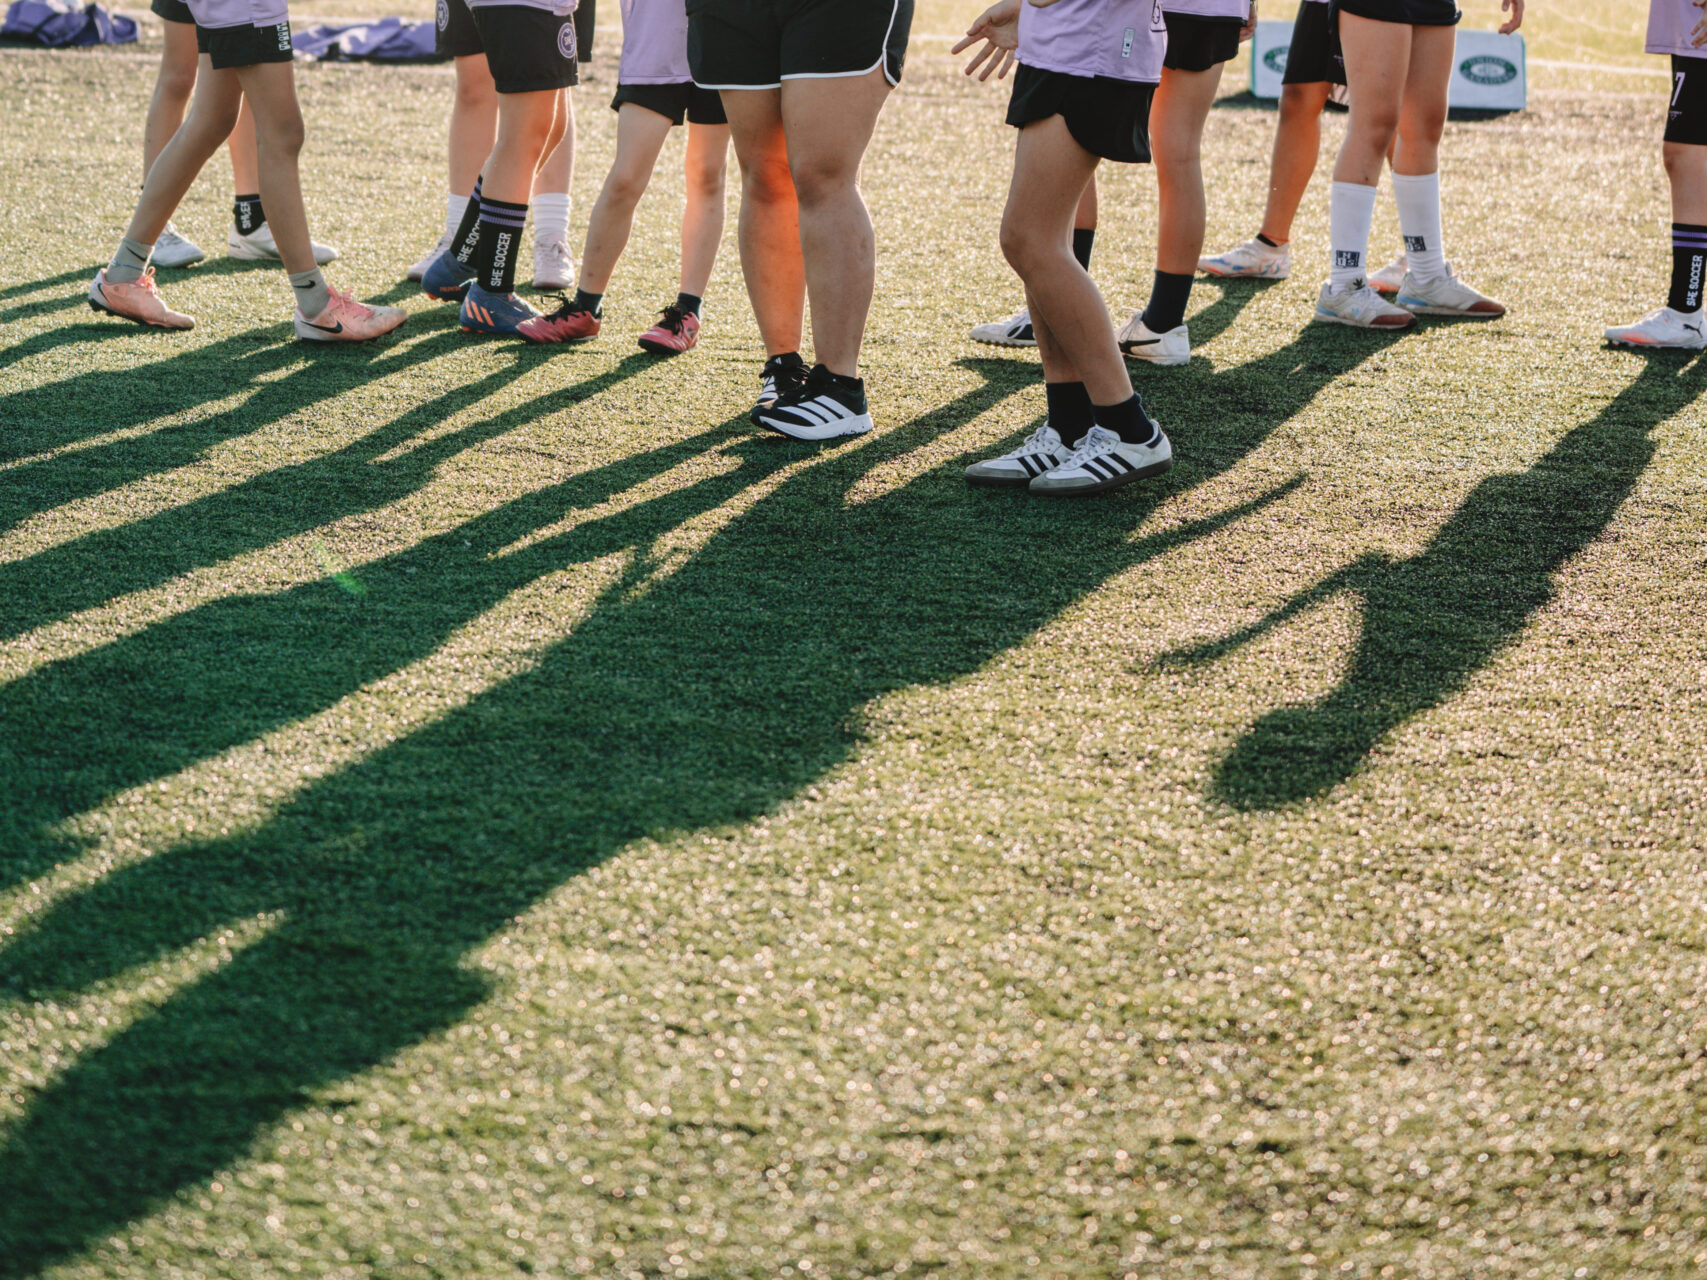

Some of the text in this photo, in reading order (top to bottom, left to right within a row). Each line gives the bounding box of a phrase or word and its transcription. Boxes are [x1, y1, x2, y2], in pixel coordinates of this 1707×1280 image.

[1671, 71, 1686, 106] 7
[456, 244, 474, 263] SHE
[490, 232, 512, 287] SHE SOCCER
[1686, 255, 1703, 307] SHE SOCCER
